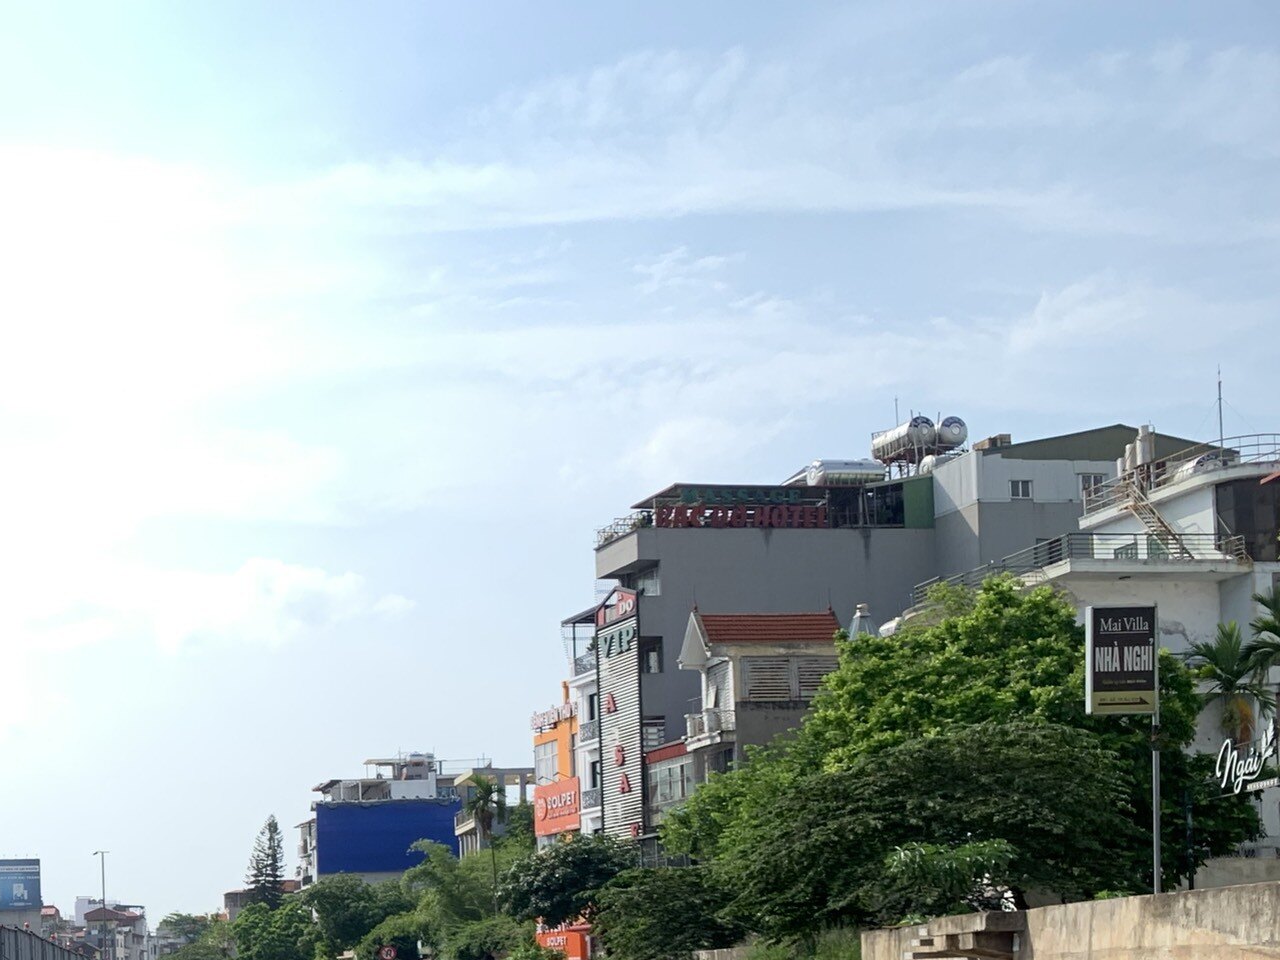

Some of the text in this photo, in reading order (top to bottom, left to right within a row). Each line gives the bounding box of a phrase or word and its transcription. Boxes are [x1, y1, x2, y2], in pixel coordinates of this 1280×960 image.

[1100, 616, 1149, 632] Mai Villa
[599, 625, 634, 658] VIP
[1095, 638, 1154, 672] NHÀ NGHỈ
[547, 791, 577, 809] SOLPET
